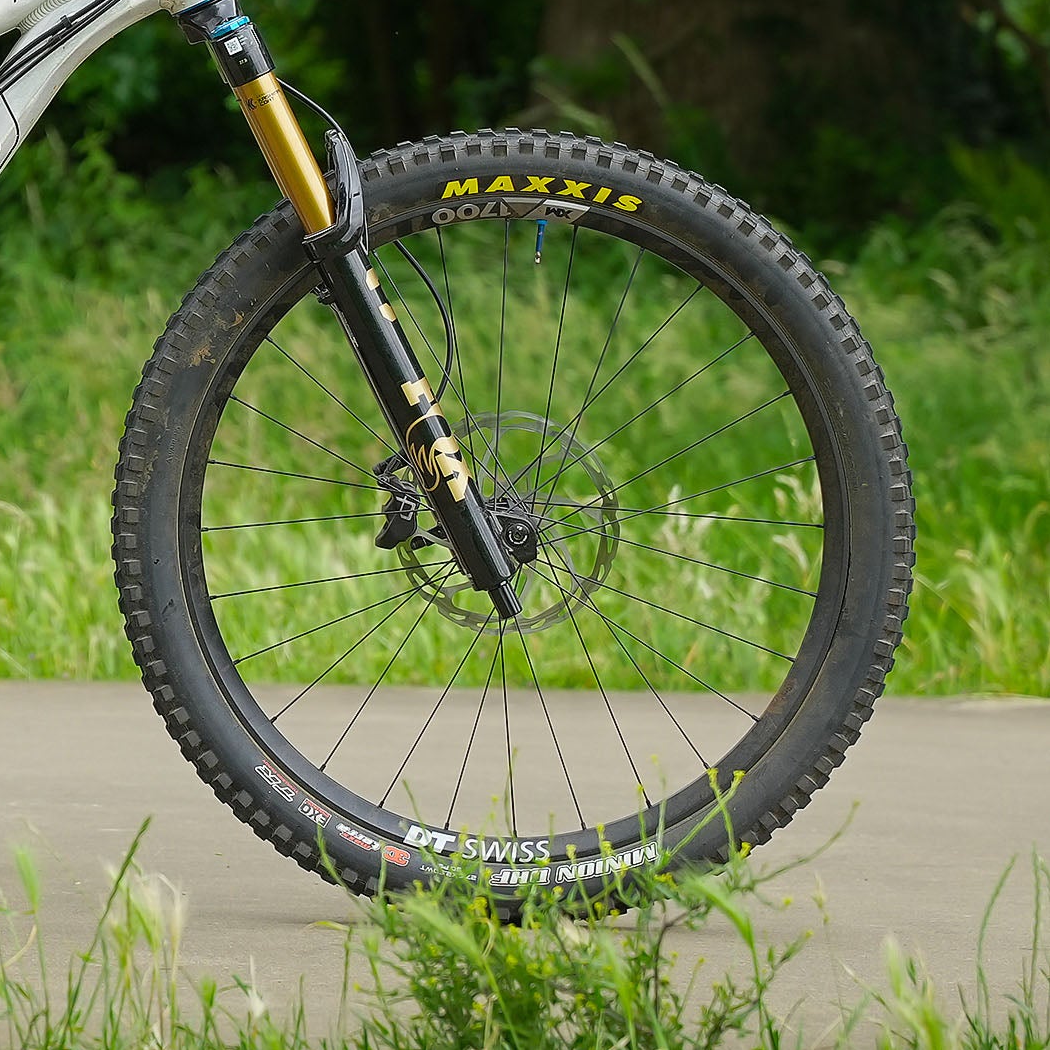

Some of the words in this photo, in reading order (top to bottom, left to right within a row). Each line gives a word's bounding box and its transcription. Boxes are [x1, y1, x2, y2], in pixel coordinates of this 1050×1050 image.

[441, 175, 643, 212] MAXXIS
[431, 200, 511, 225] 1700
[255, 764, 296, 802] TR
[300, 805, 327, 825] EXO
[382, 845, 411, 867] 3C
[403, 824, 457, 854] DT
[462, 839, 550, 864] SWISS
[489, 866, 551, 887] DHF
[555, 841, 658, 883] MINION
